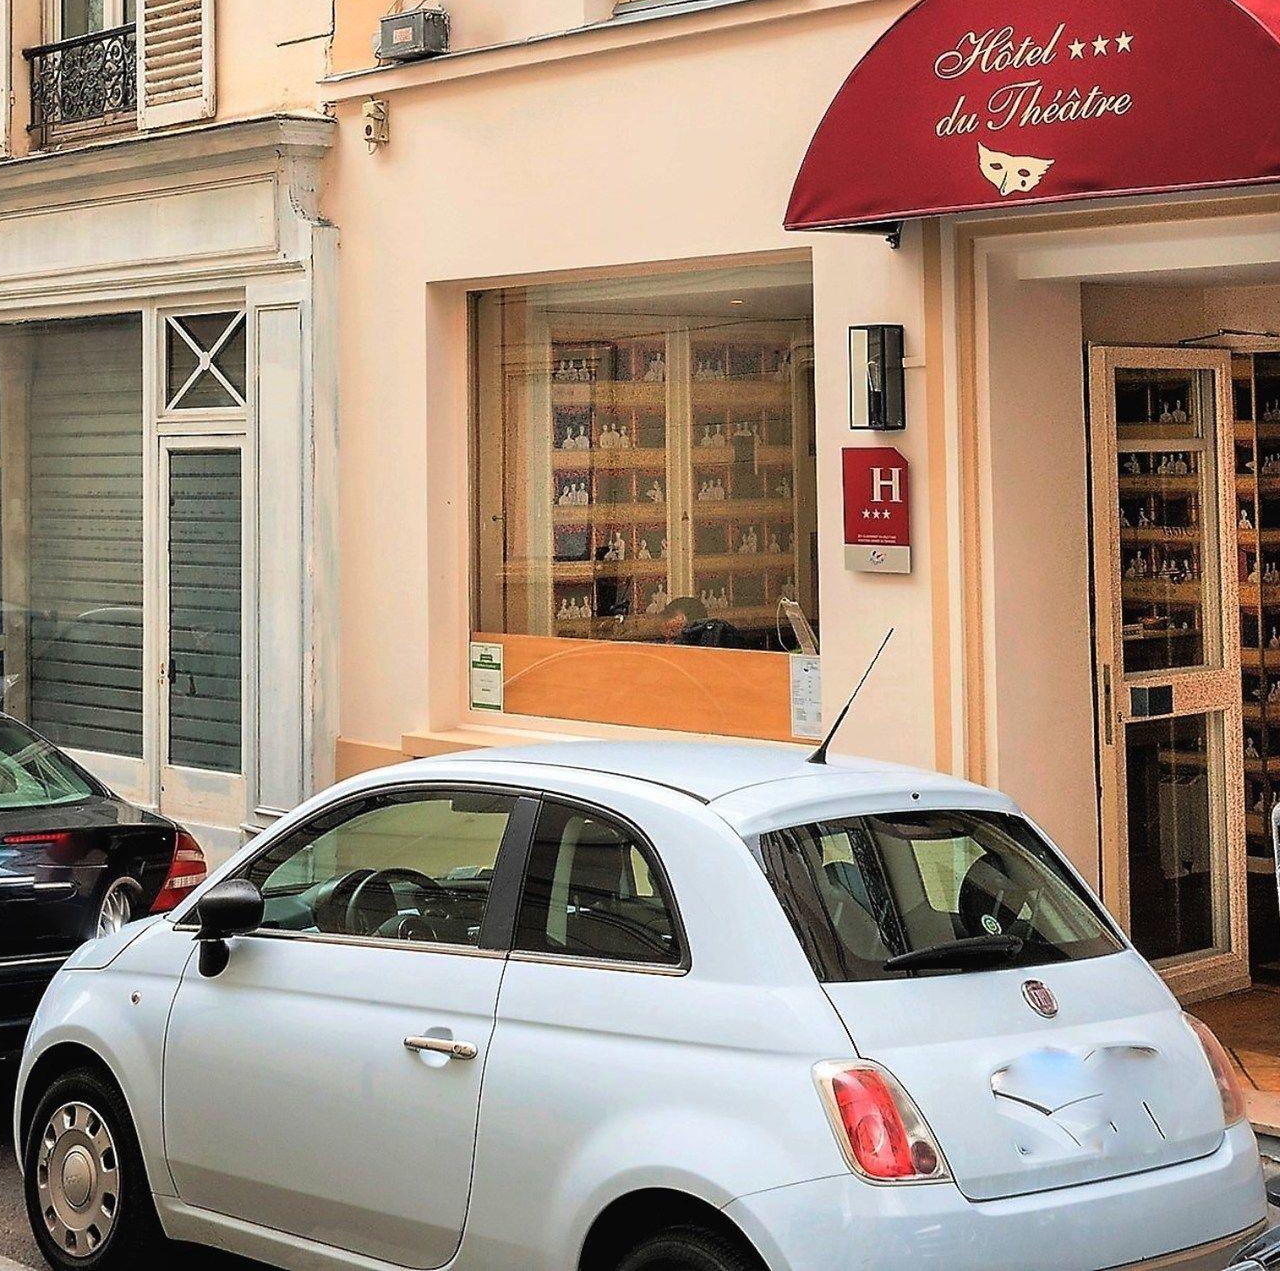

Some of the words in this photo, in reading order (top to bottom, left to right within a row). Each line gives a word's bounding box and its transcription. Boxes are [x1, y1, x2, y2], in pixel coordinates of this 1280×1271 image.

[933, 22, 1067, 80] Hôtel
[935, 94, 980, 138] du
[986, 78, 1133, 131] Théâtre
[870, 467, 902, 502] H
